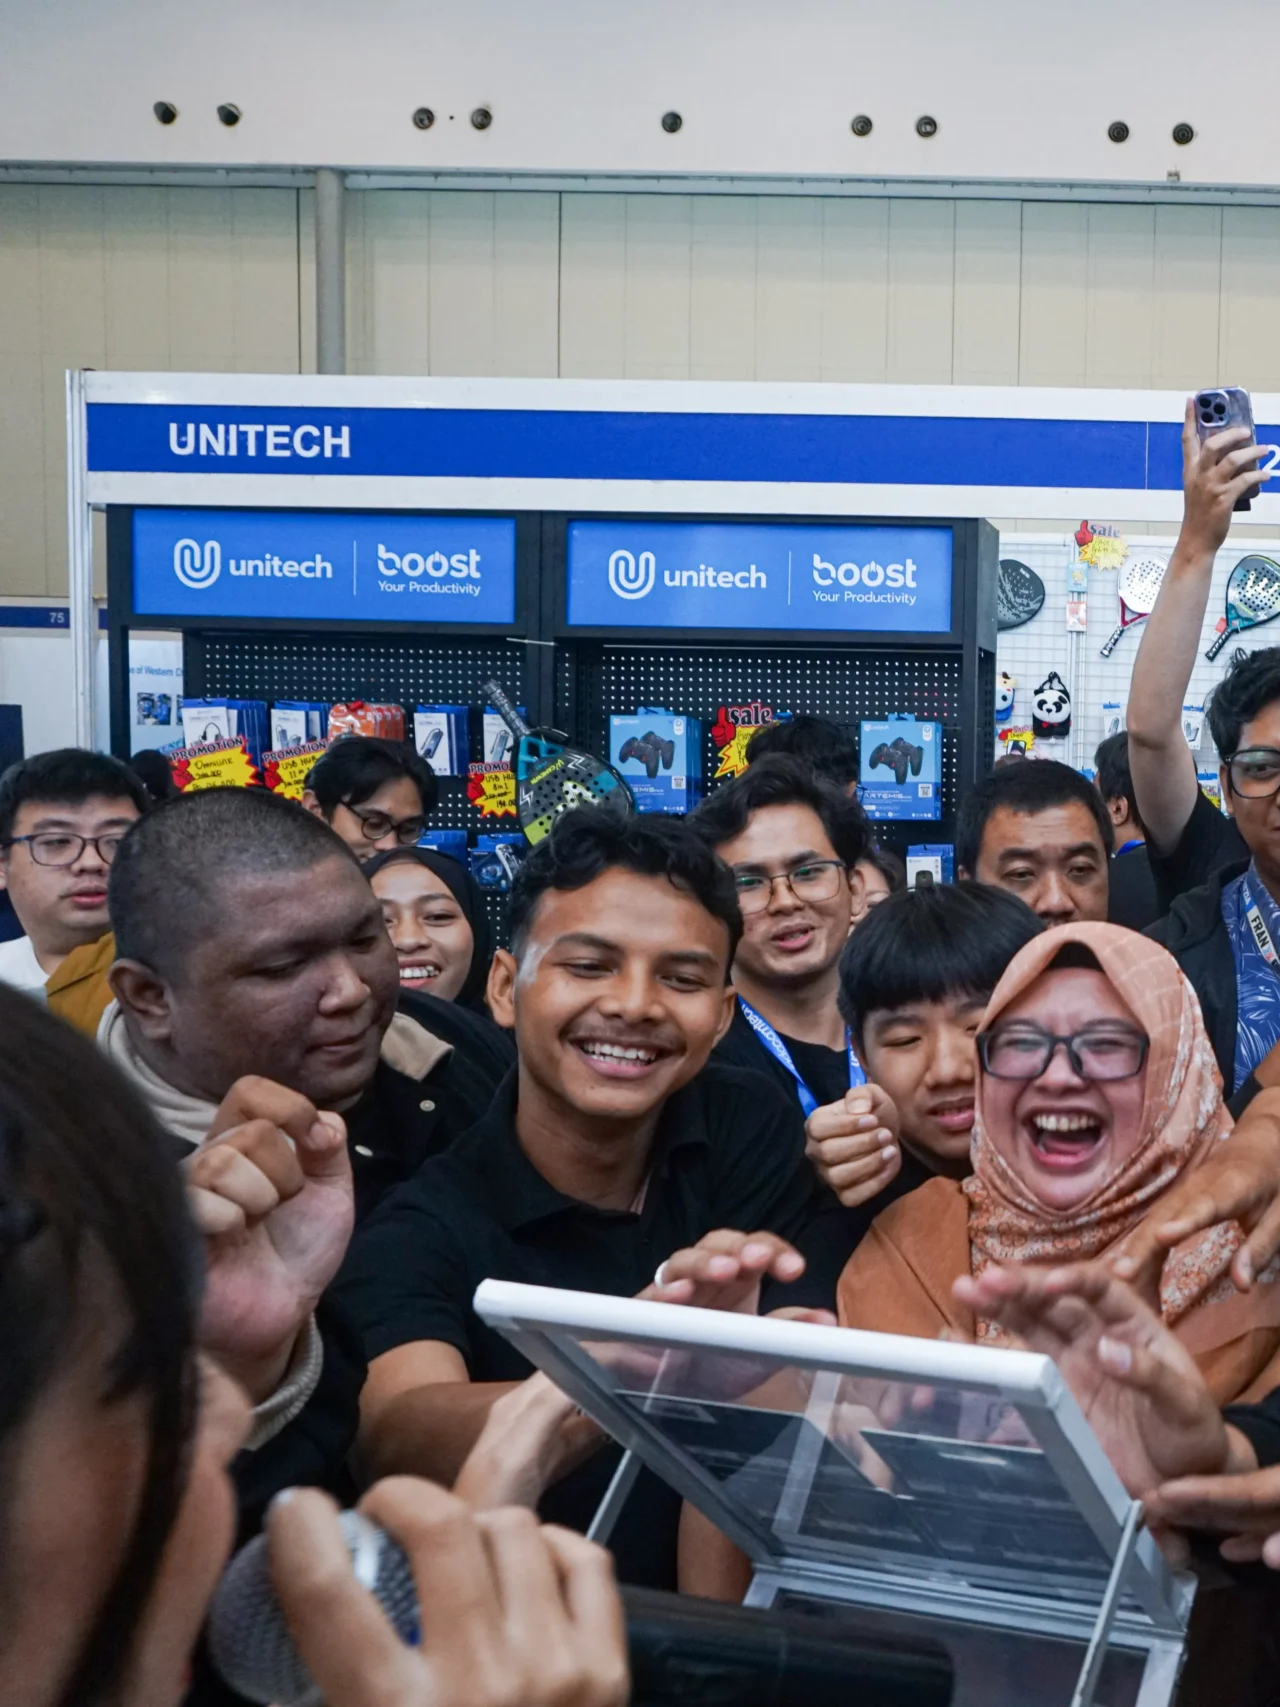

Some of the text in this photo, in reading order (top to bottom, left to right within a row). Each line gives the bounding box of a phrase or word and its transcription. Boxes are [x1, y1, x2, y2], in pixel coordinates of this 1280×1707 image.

[169, 422, 351, 458] UNITECH
[229, 553, 333, 578] unitech
[377, 543, 481, 578] boost
[812, 553, 917, 588] boost
[664, 564, 767, 588] unitech
[378, 580, 481, 597] Your Productivity
[812, 590, 917, 606] Your Productivity
[50, 612, 65, 624] 75
[145, 666, 173, 676] Western
[171, 736, 243, 762] PROMOTION
[263, 740, 328, 762] PROMOTION
[469, 763, 509, 774] PROMO
